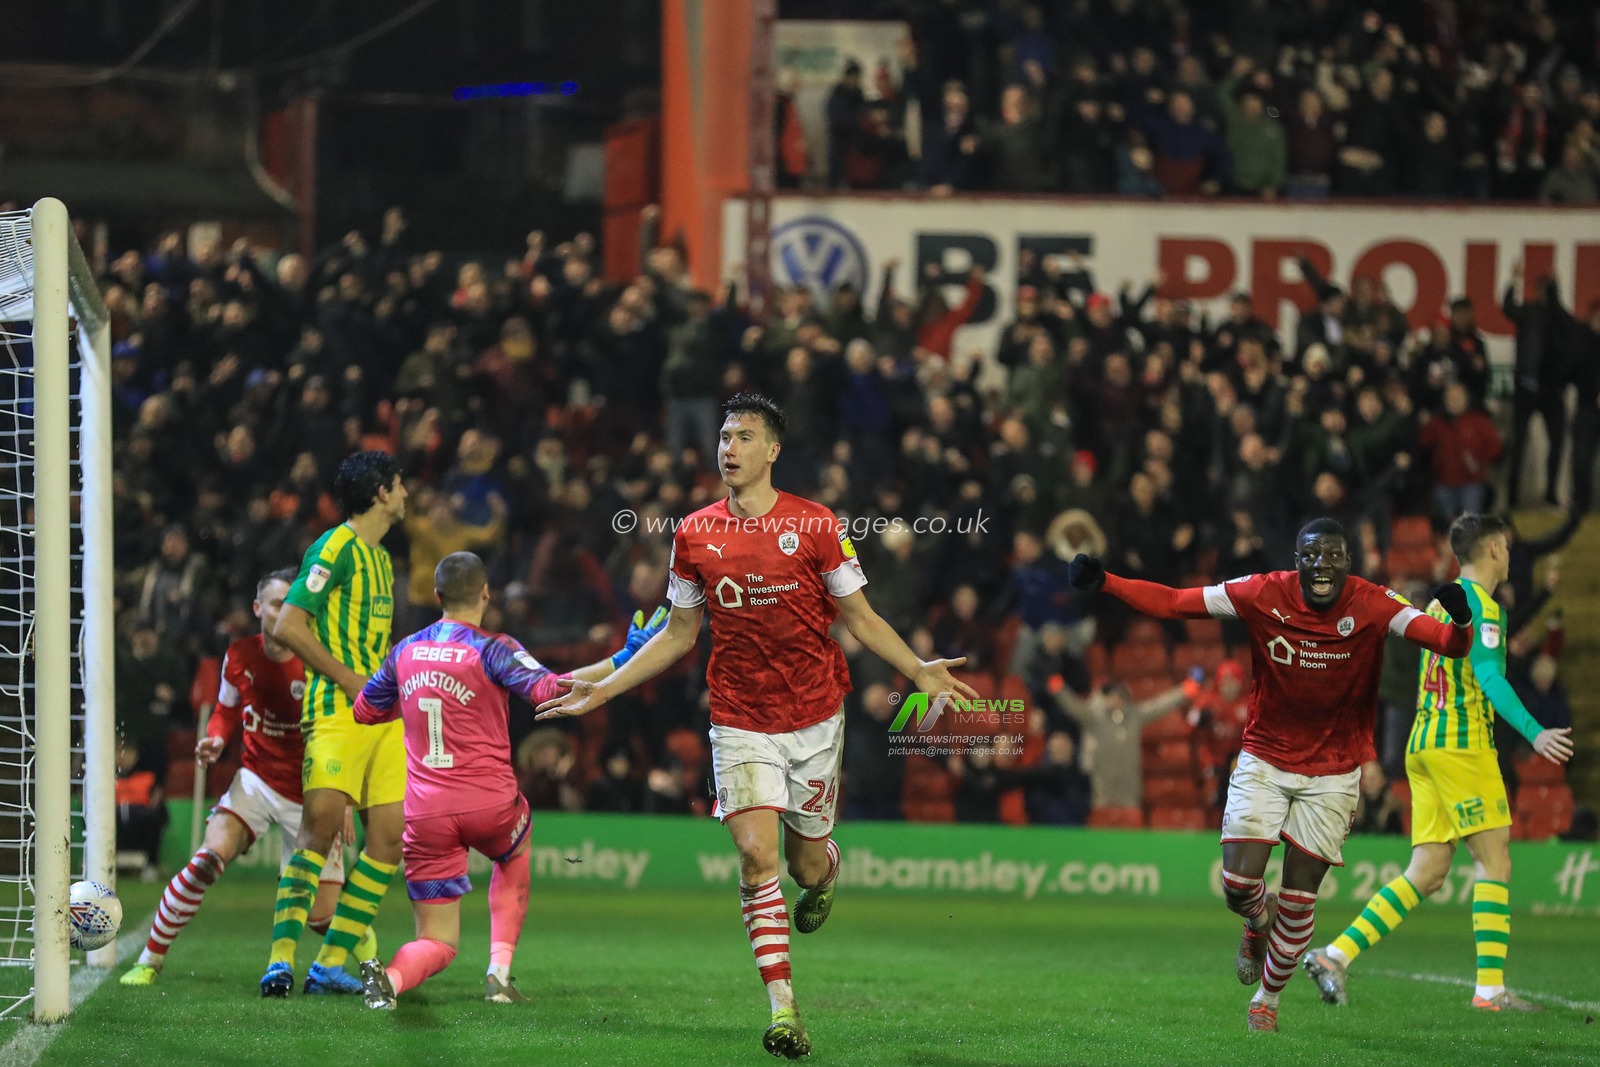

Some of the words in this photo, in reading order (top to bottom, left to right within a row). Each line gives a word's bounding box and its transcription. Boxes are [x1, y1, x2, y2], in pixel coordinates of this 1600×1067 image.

[1156, 235, 1600, 337] PROU
[745, 573, 764, 583] The
[747, 581, 799, 595] Investment
[749, 597, 778, 606] Room
[1300, 640, 1318, 649] The
[411, 645, 468, 664] 12BET
[1300, 649, 1352, 660] Investment
[1299, 660, 1328, 670] Room
[401, 670, 477, 706] JOHNSTONE
[418, 697, 454, 769] 1
